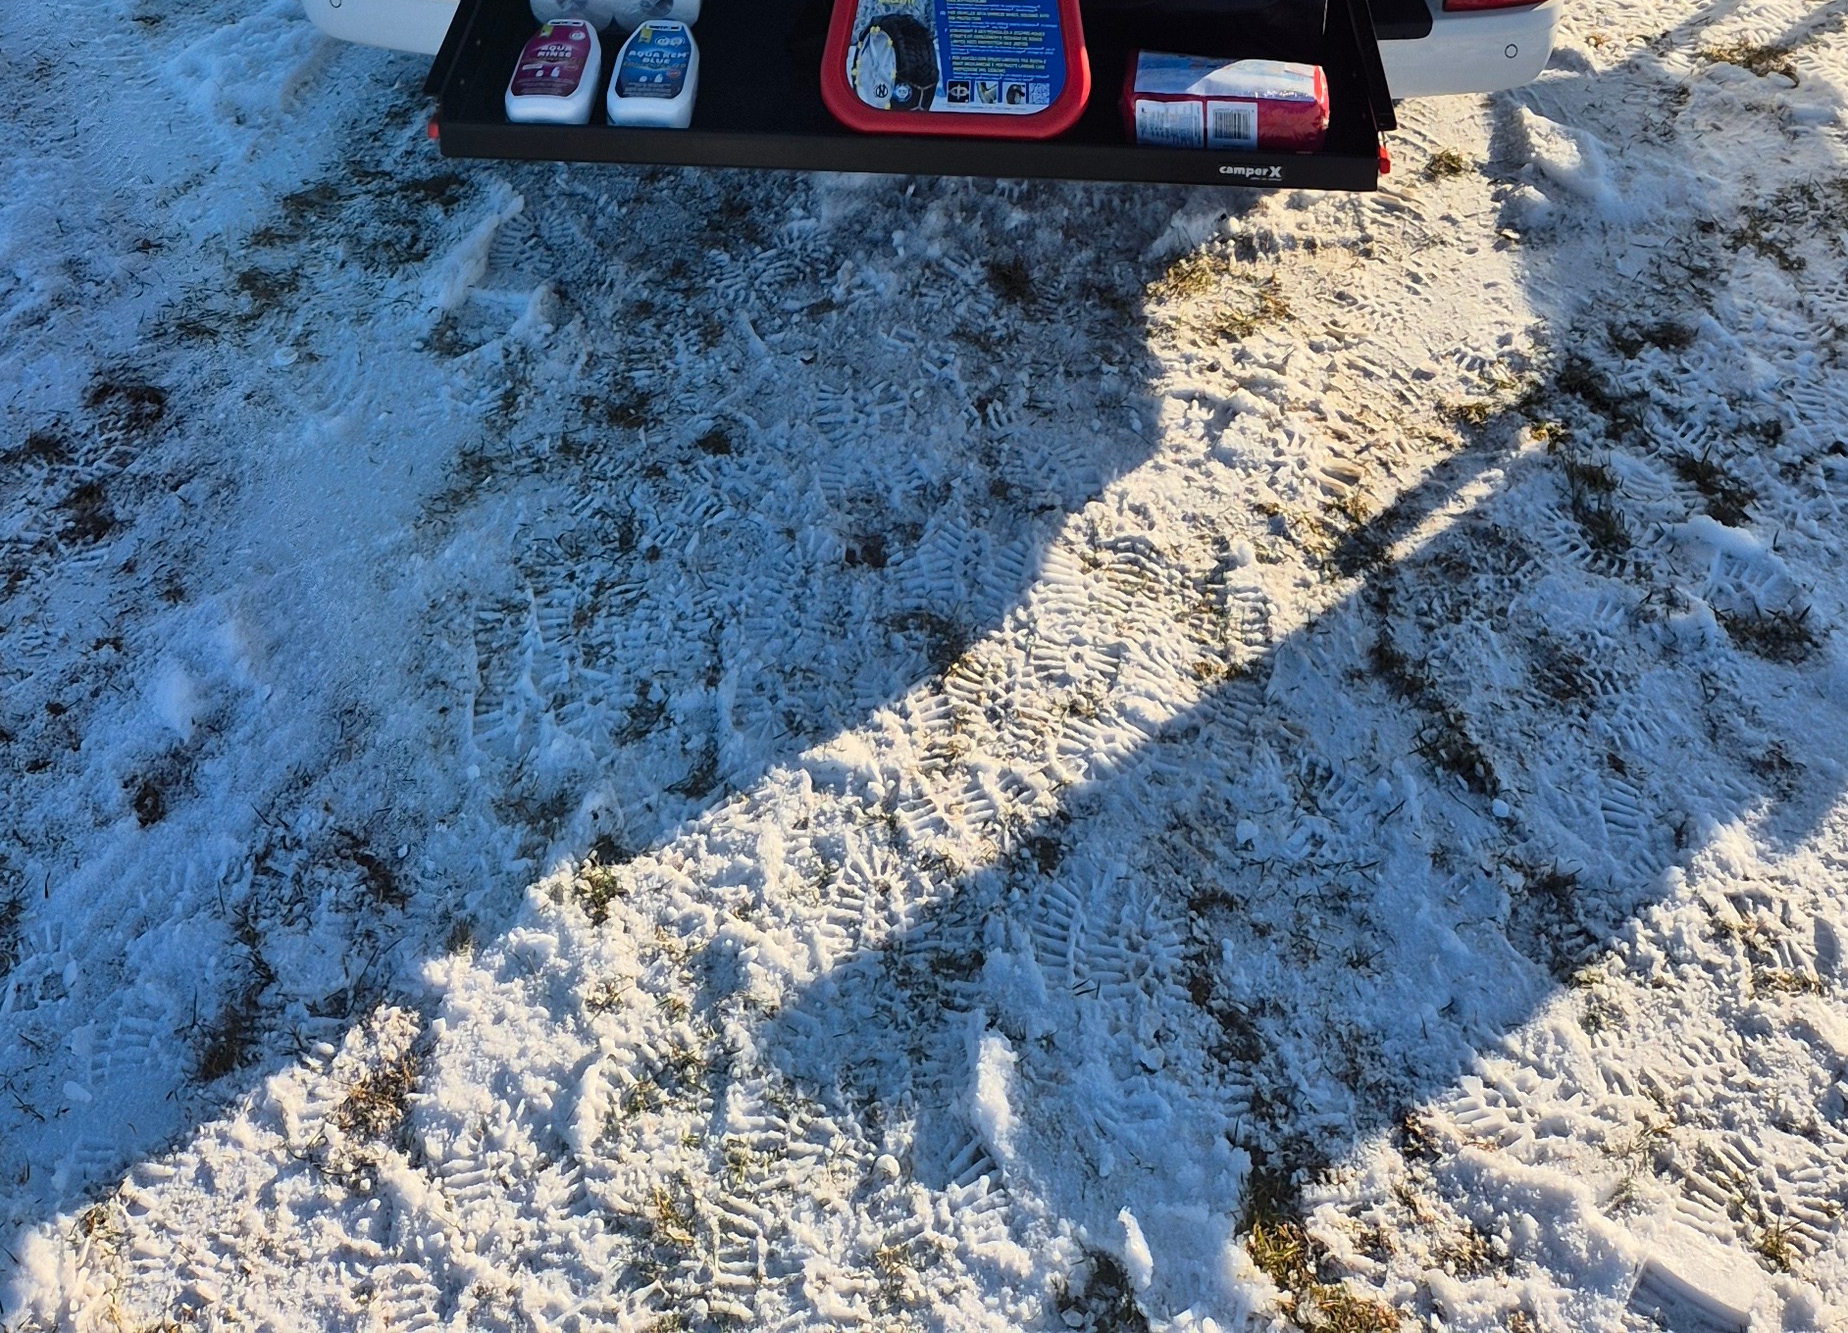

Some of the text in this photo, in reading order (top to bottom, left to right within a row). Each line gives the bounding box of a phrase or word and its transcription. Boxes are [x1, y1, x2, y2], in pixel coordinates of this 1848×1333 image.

[541, 44, 573, 52] AQUA
[628, 50, 660, 58] AQUA
[642, 57, 671, 65] BLUE
